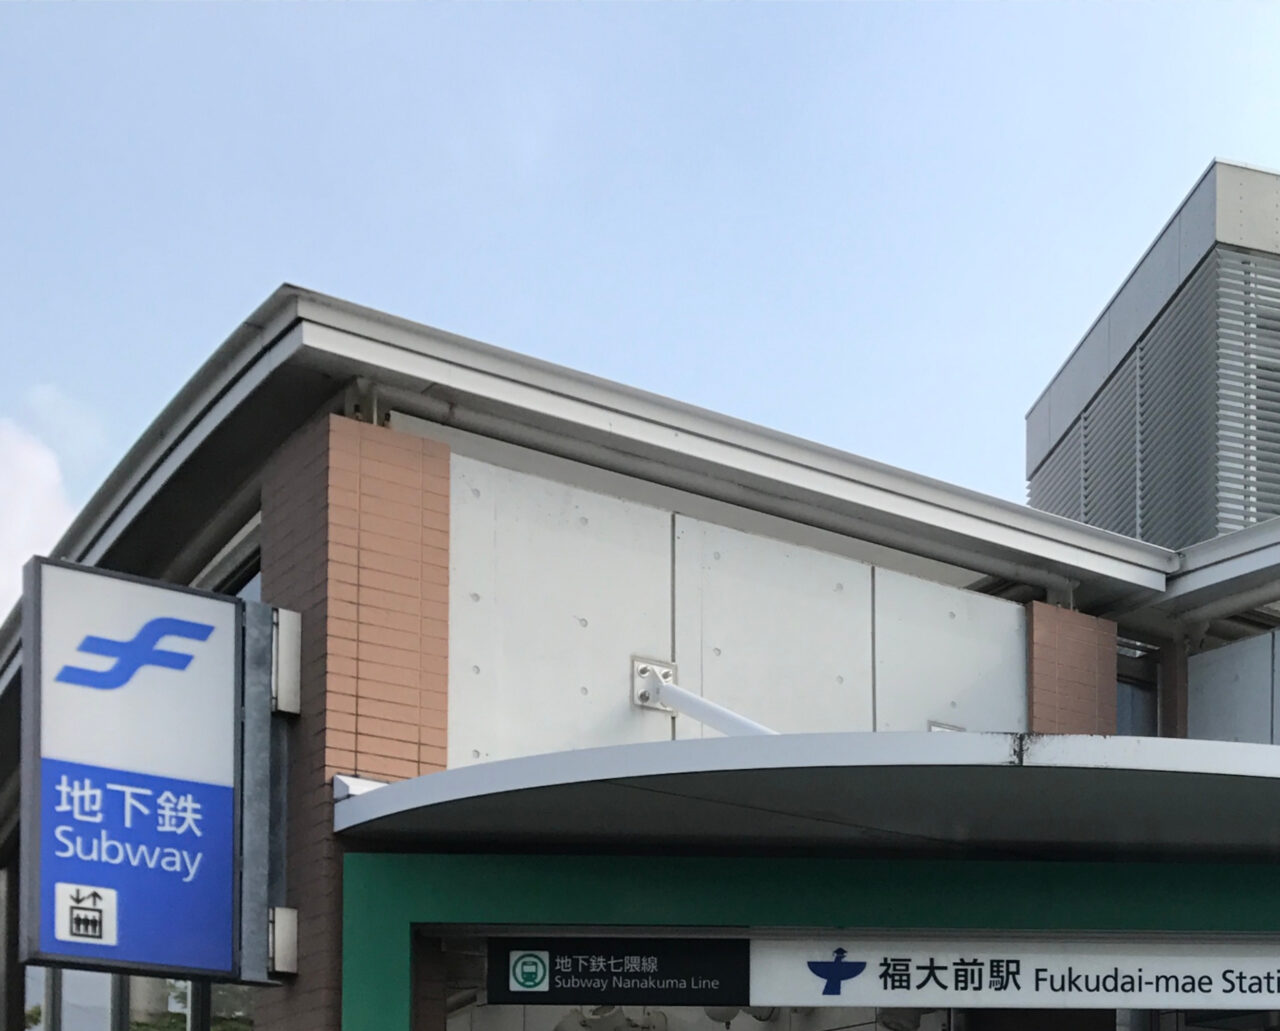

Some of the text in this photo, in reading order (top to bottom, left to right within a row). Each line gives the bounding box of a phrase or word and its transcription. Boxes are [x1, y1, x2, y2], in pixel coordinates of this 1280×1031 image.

[54, 775, 203, 837] 地下鉄
[54, 826, 203, 882] Subway
[554, 954, 659, 973] 地下鉄七隈線
[879, 957, 1022, 992] 福大前駅
[1034, 967, 1213, 994] Fukudai-mae
[554, 975, 720, 992] Subway Nanakuma Line
